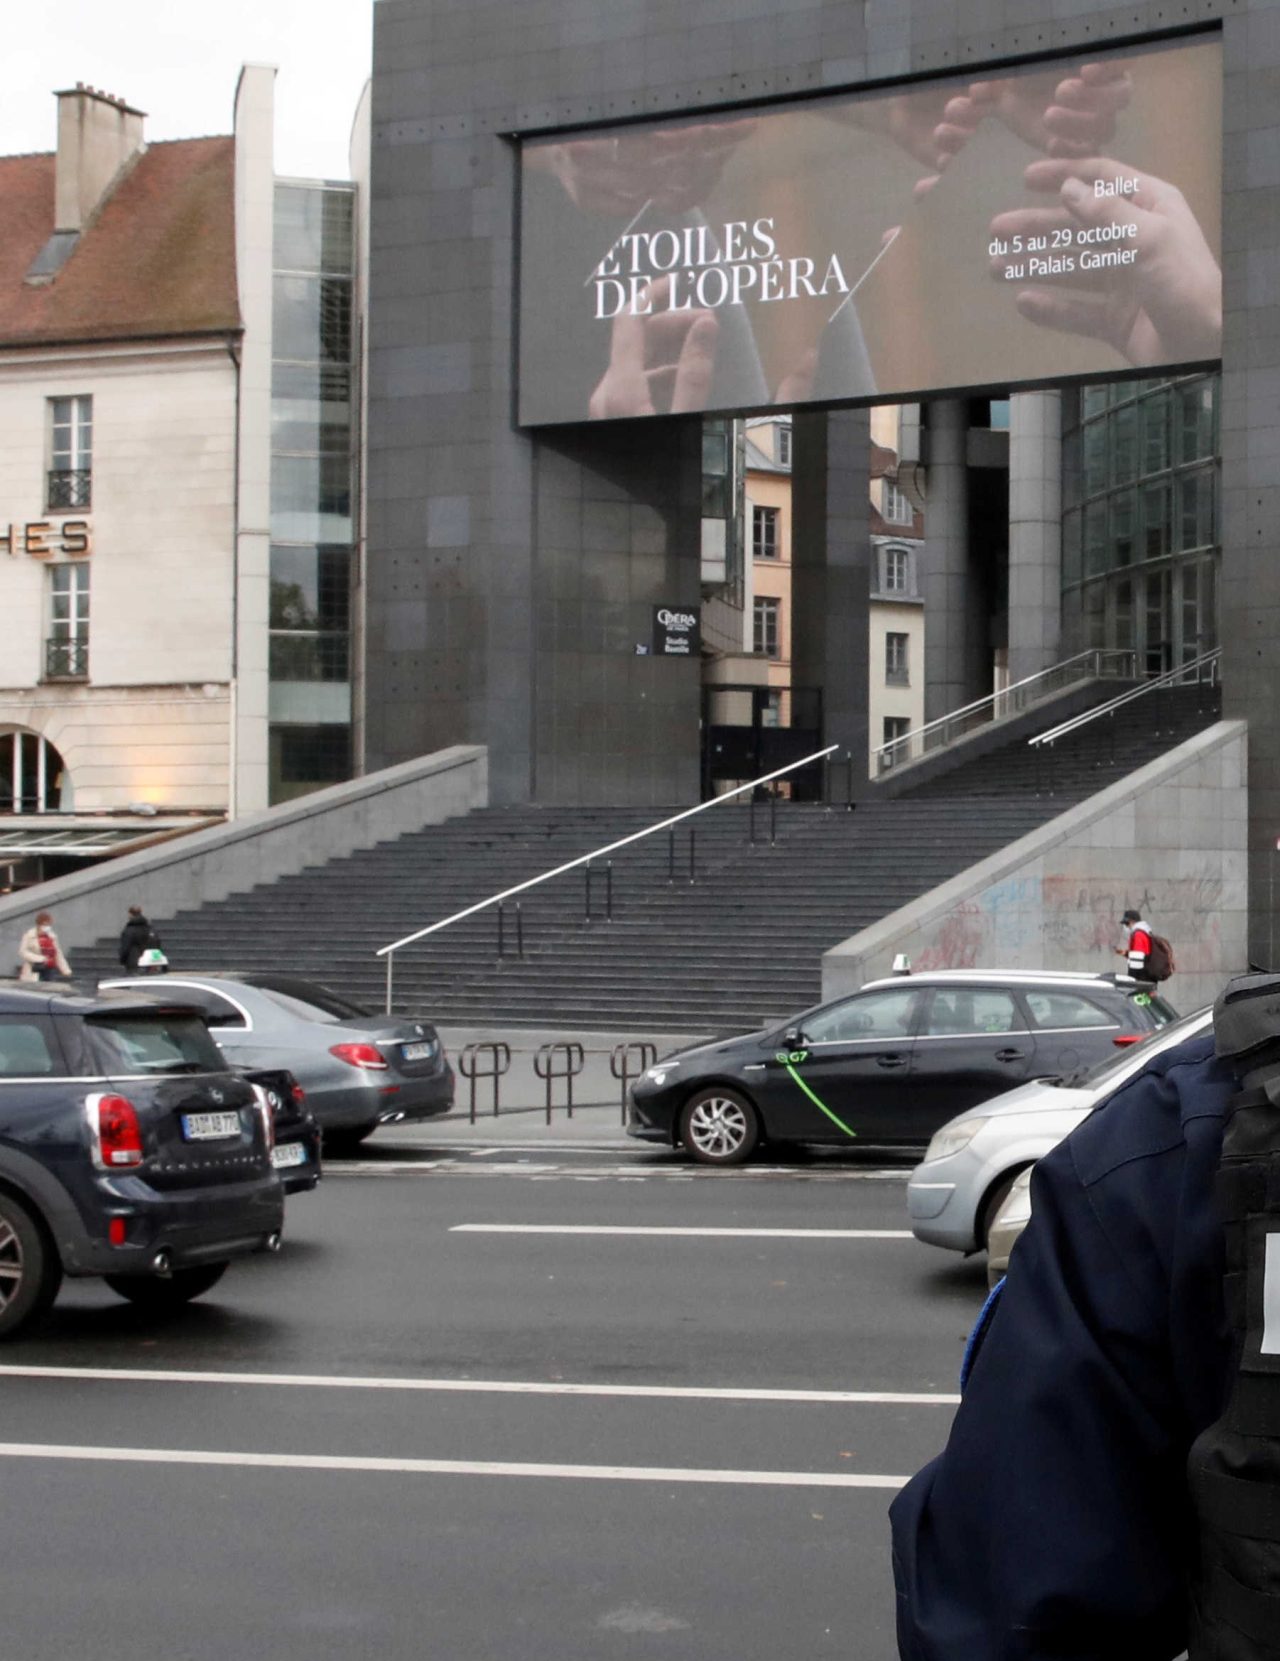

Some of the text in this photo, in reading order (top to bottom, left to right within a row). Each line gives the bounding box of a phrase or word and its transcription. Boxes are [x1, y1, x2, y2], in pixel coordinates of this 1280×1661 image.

[1094, 175, 1139, 198] Ballet
[988, 221, 1138, 256] du 5 au 29 octobre
[1005, 248, 1139, 279] au Palais Garnier
[594, 275, 653, 319] DE
